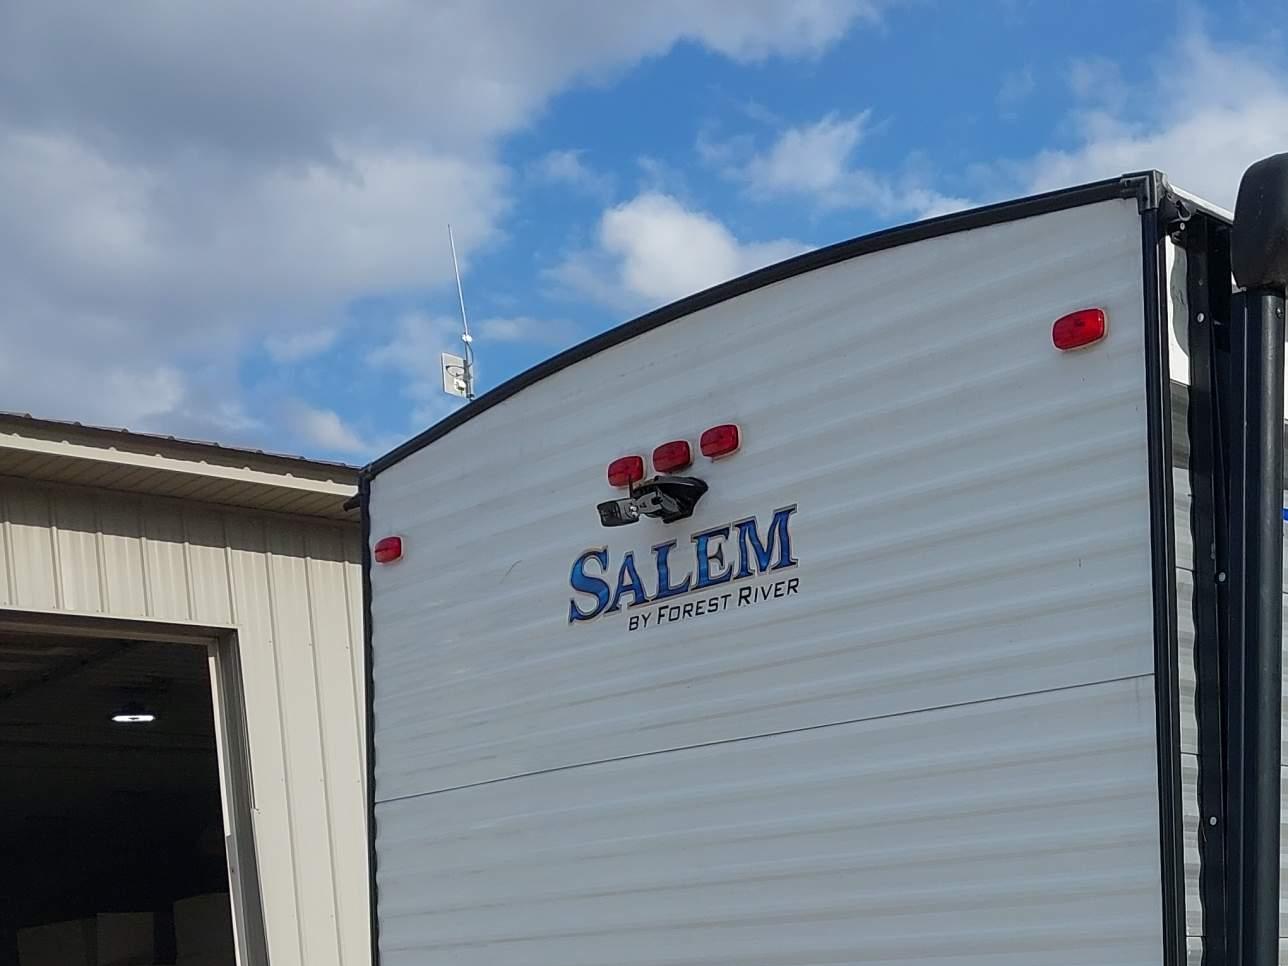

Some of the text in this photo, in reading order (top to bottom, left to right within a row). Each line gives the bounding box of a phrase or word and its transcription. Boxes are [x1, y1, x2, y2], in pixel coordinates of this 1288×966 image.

[568, 503, 798, 626] SALEM
[628, 577, 800, 632] BY FOREST RIVER
